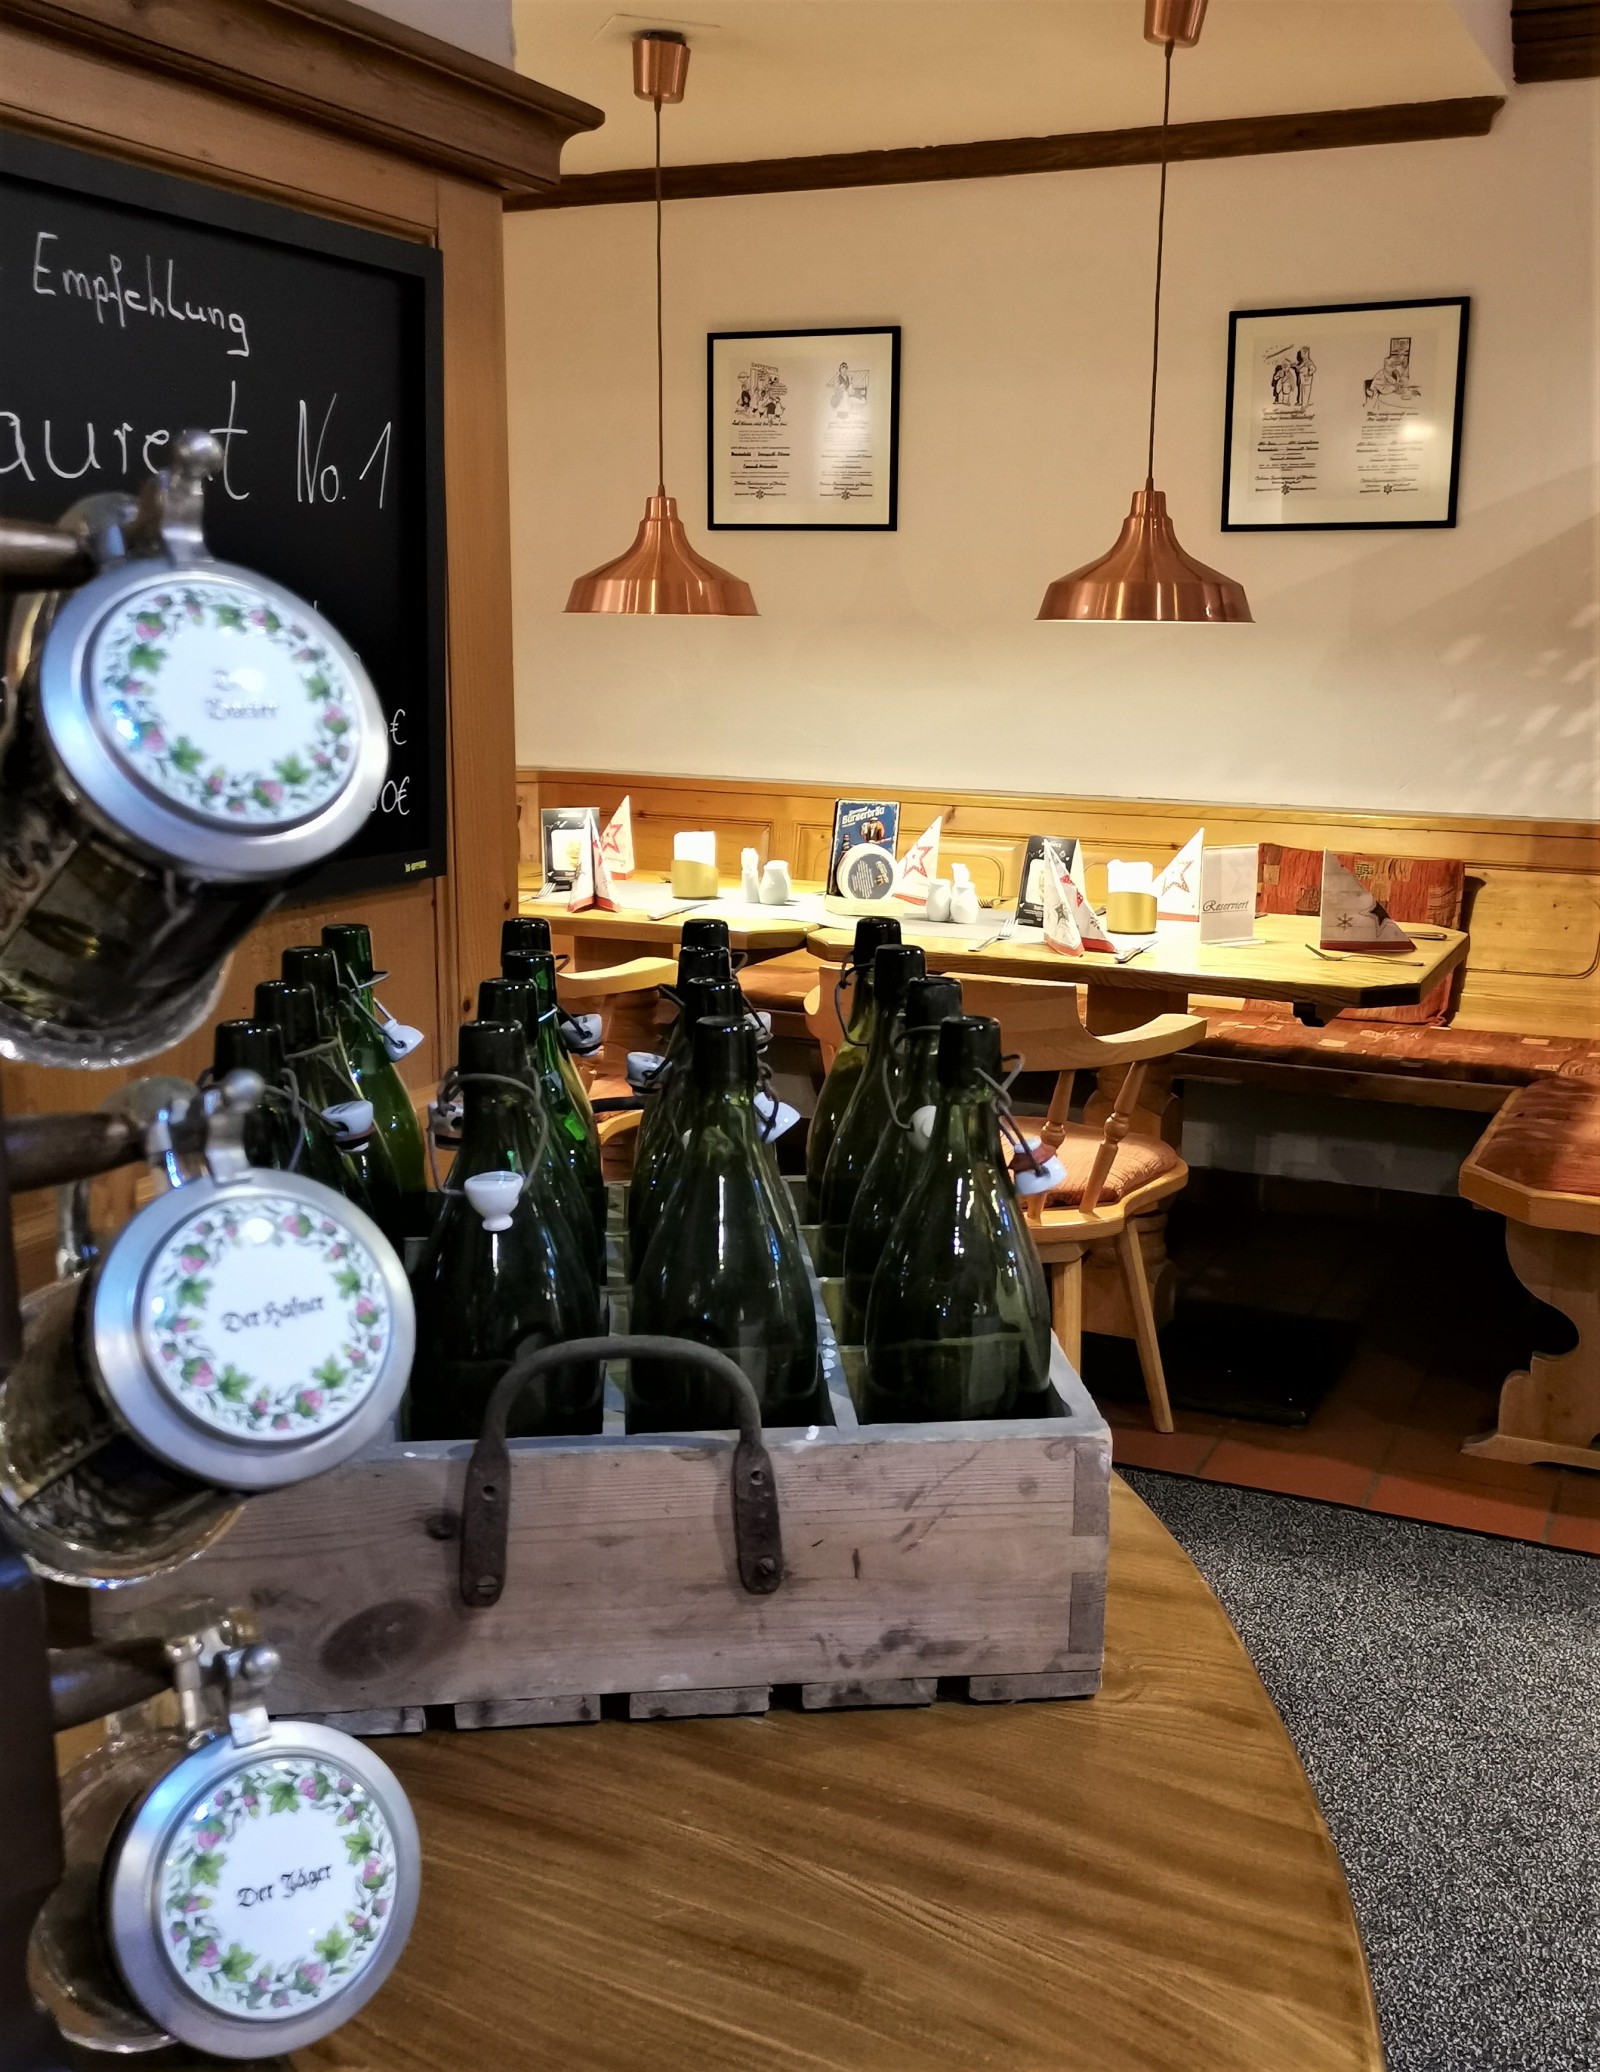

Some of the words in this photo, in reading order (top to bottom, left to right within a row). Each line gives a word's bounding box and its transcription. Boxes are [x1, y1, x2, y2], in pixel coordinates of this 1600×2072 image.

[33, 231, 250, 357] Empfehlung
[0, 380, 250, 500] auret
[238, 1885, 273, 1907] Der
